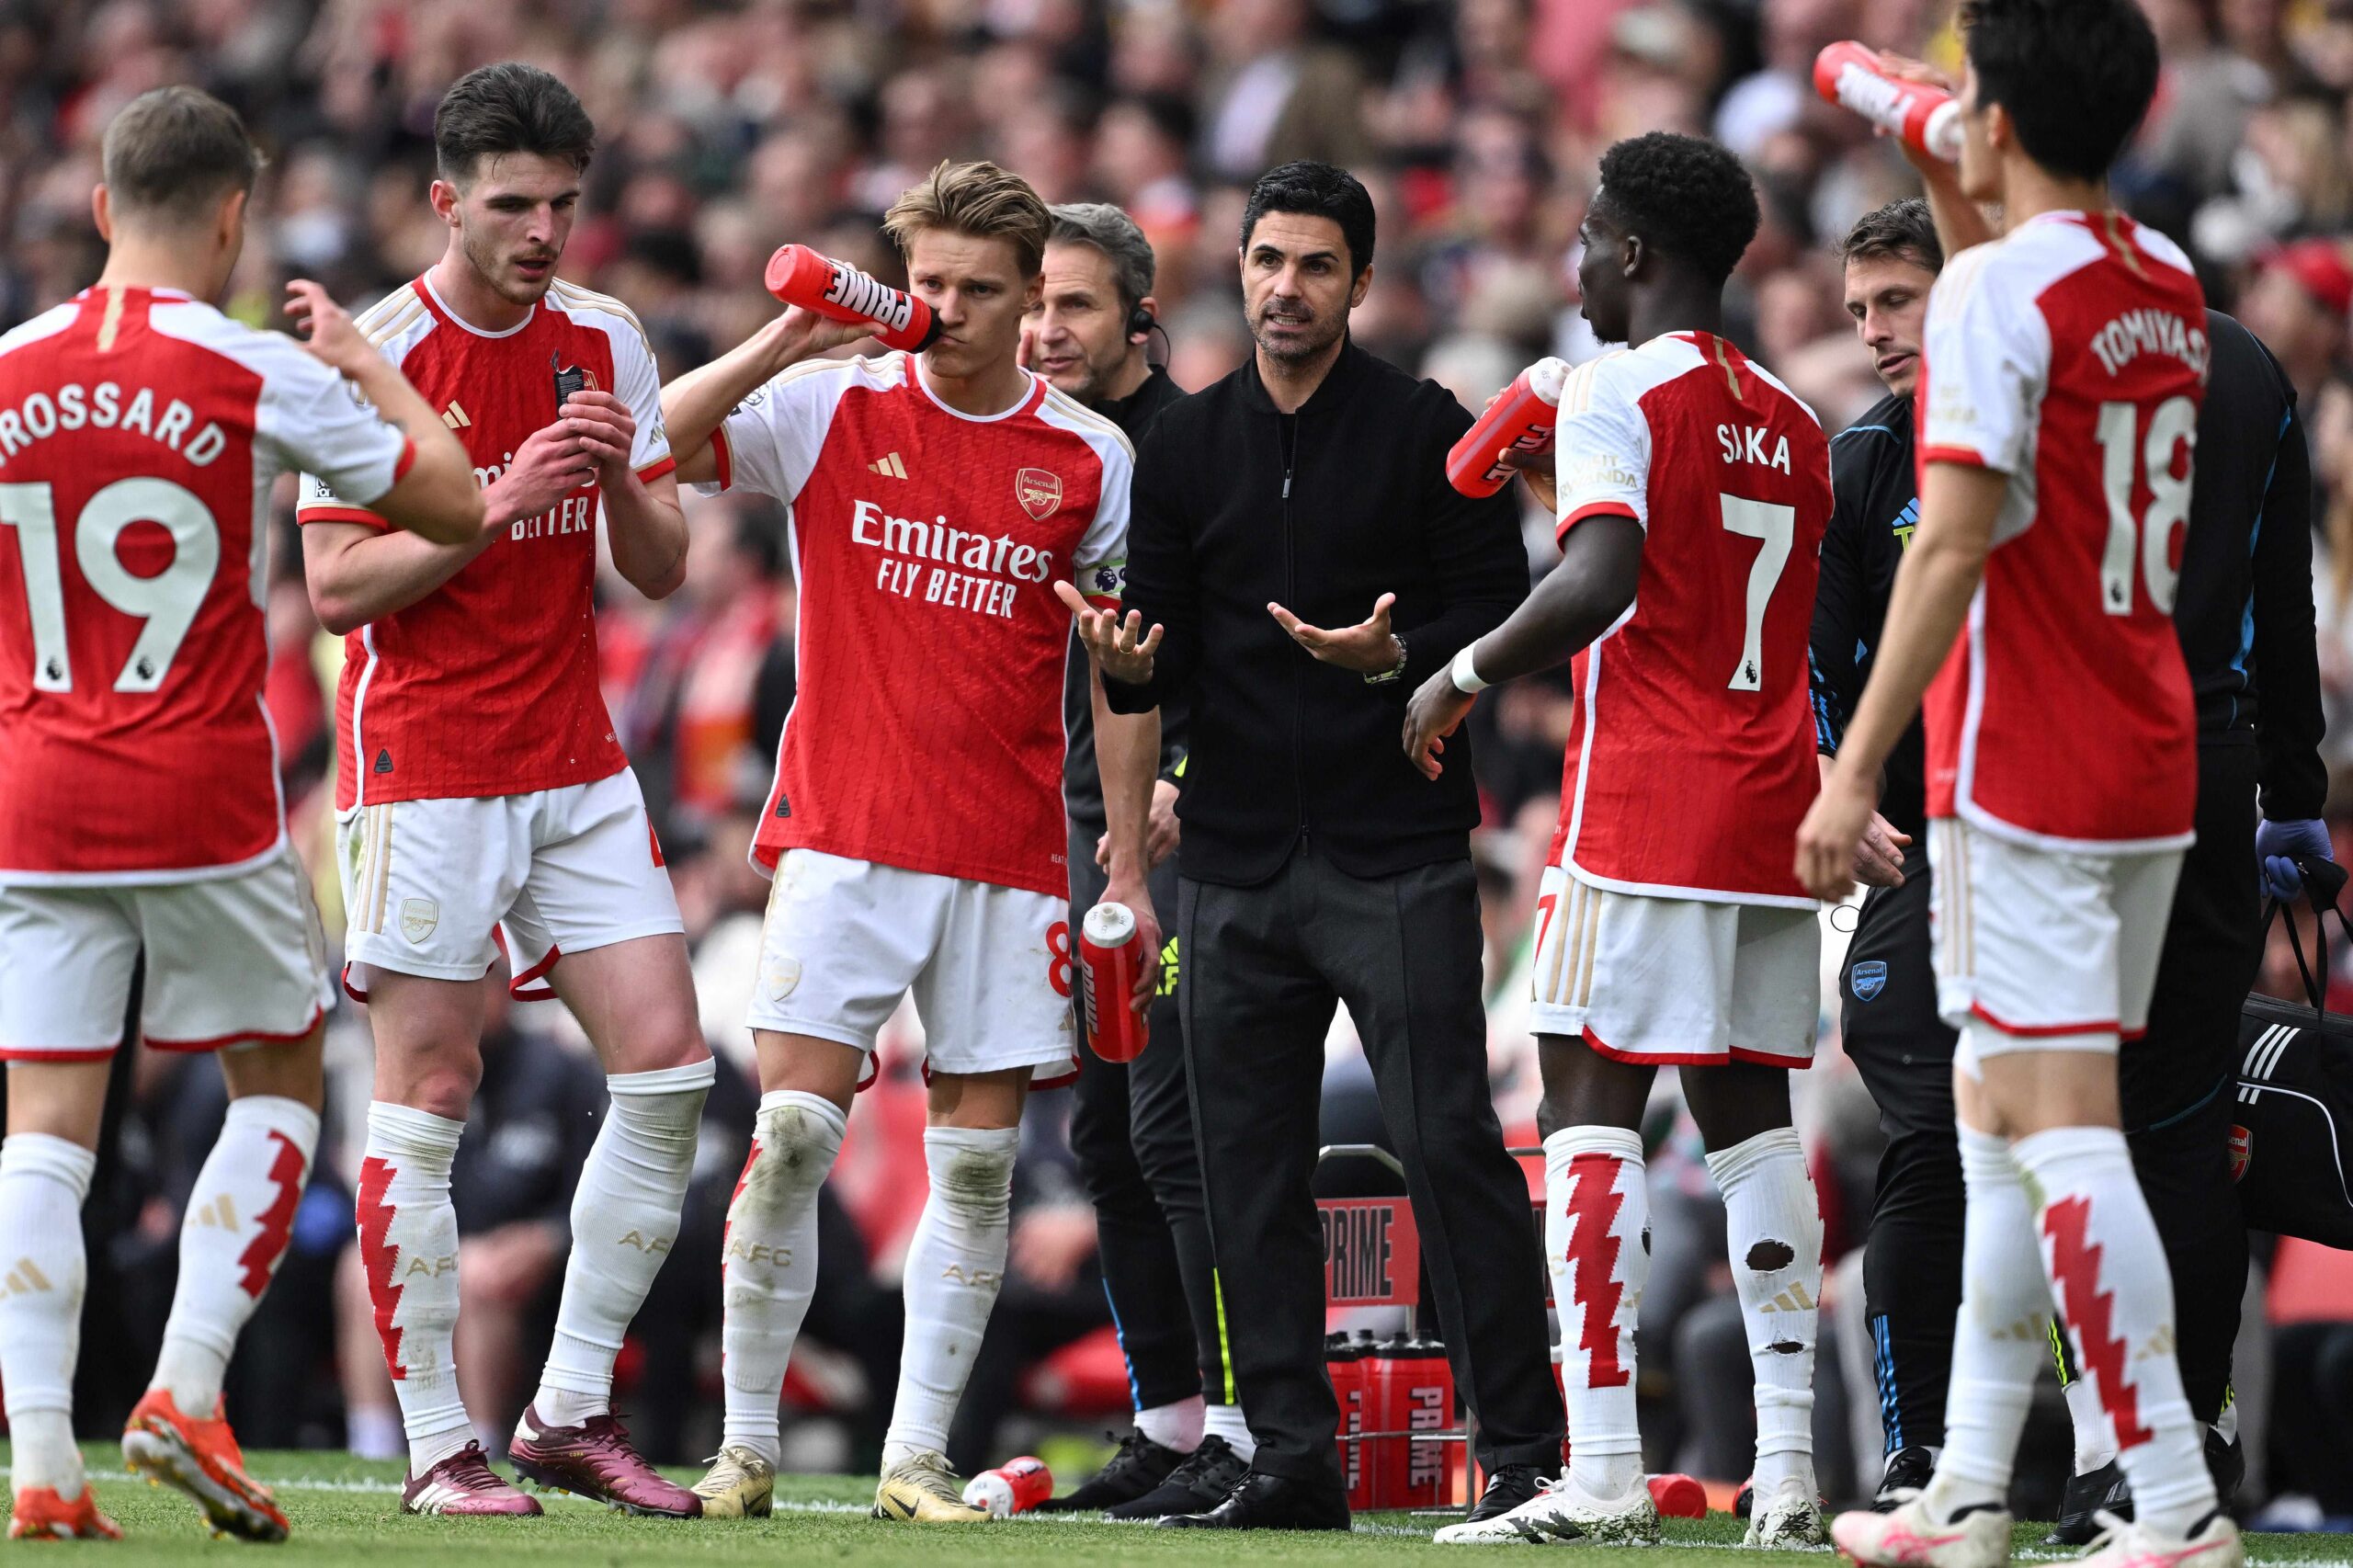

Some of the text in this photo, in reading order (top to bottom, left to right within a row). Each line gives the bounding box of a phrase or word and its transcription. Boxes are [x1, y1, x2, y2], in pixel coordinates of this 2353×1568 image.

[824, 257, 913, 333] PRIME
[0, 381, 227, 467] ROSSARD
[1717, 423, 1790, 476] SAKA
[1023, 476, 1056, 490] Arsenal
[2094, 395, 2198, 616] 18
[851, 499, 1053, 584] Emirates
[0, 475, 222, 693] 19
[877, 557, 1017, 619] FLY BETTER
[1720, 492, 1796, 691] 7
[1046, 921, 1073, 997] 8
[1856, 967, 1882, 976] Arsenal
[2228, 1136, 2247, 1148] enal
[617, 1229, 671, 1254] AF
[730, 1238, 792, 1267] AFC
[1411, 1386, 1444, 1488] PRME
